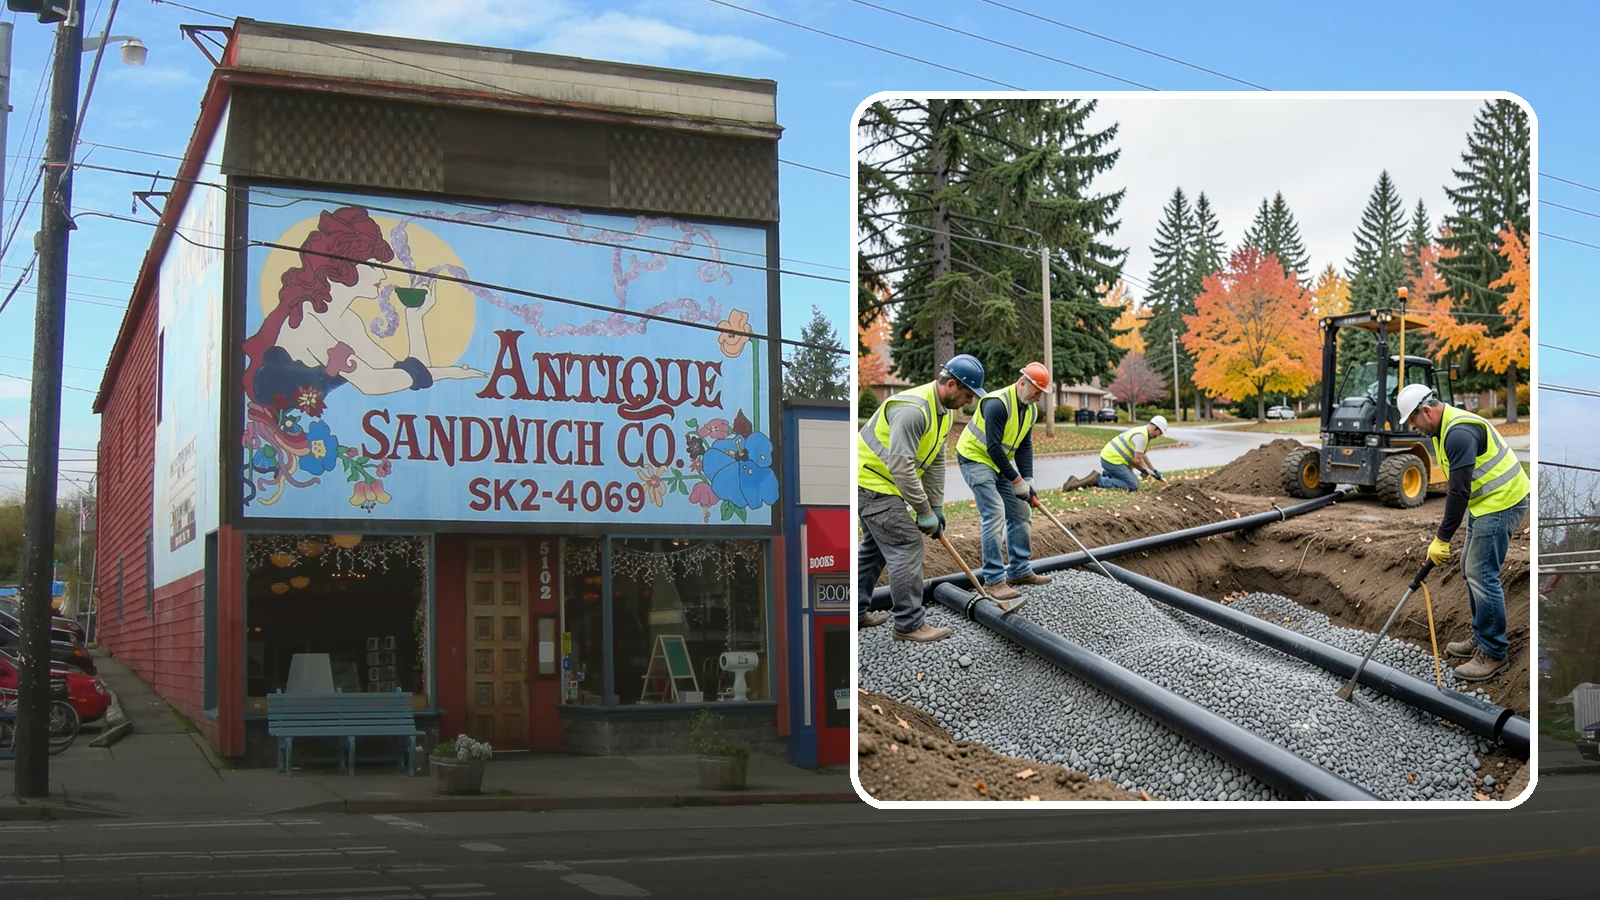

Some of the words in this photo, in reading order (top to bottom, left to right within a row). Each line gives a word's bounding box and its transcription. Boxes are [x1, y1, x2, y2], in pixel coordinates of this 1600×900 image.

[475, 328, 723, 421] ANTIQUE
[360, 409, 604, 468] SANDWICH
[616, 421, 686, 470] CO.
[467, 476, 647, 514] SK2-4069
[540, 541, 552, 600] 5102
[809, 555, 835, 569] BOOKS
